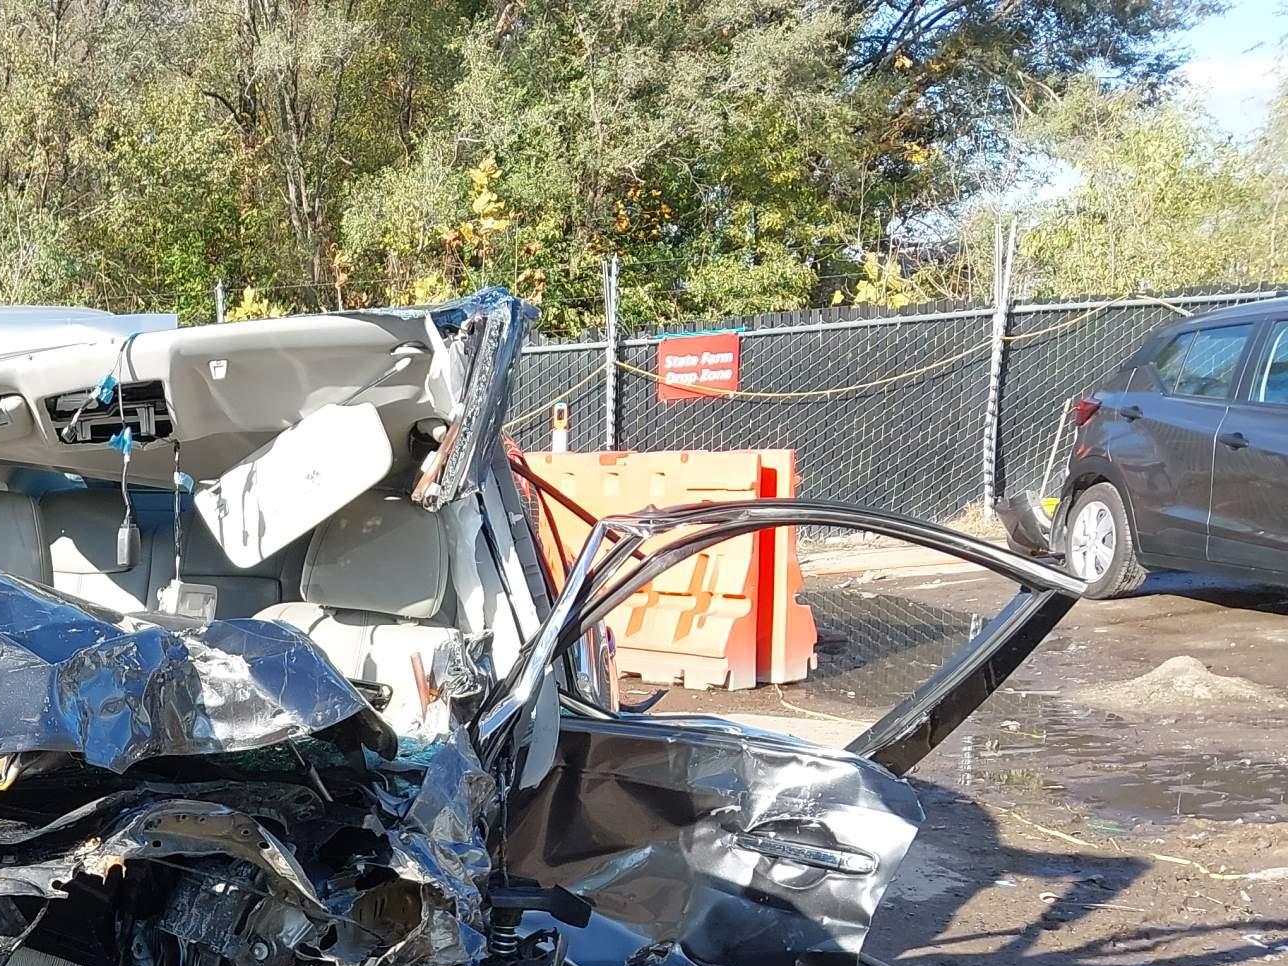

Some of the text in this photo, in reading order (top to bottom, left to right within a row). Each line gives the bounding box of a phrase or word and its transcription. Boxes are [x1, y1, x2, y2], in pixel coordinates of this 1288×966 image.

[664, 352, 733, 368] State Farm
[665, 369, 733, 385] Drop Zone
